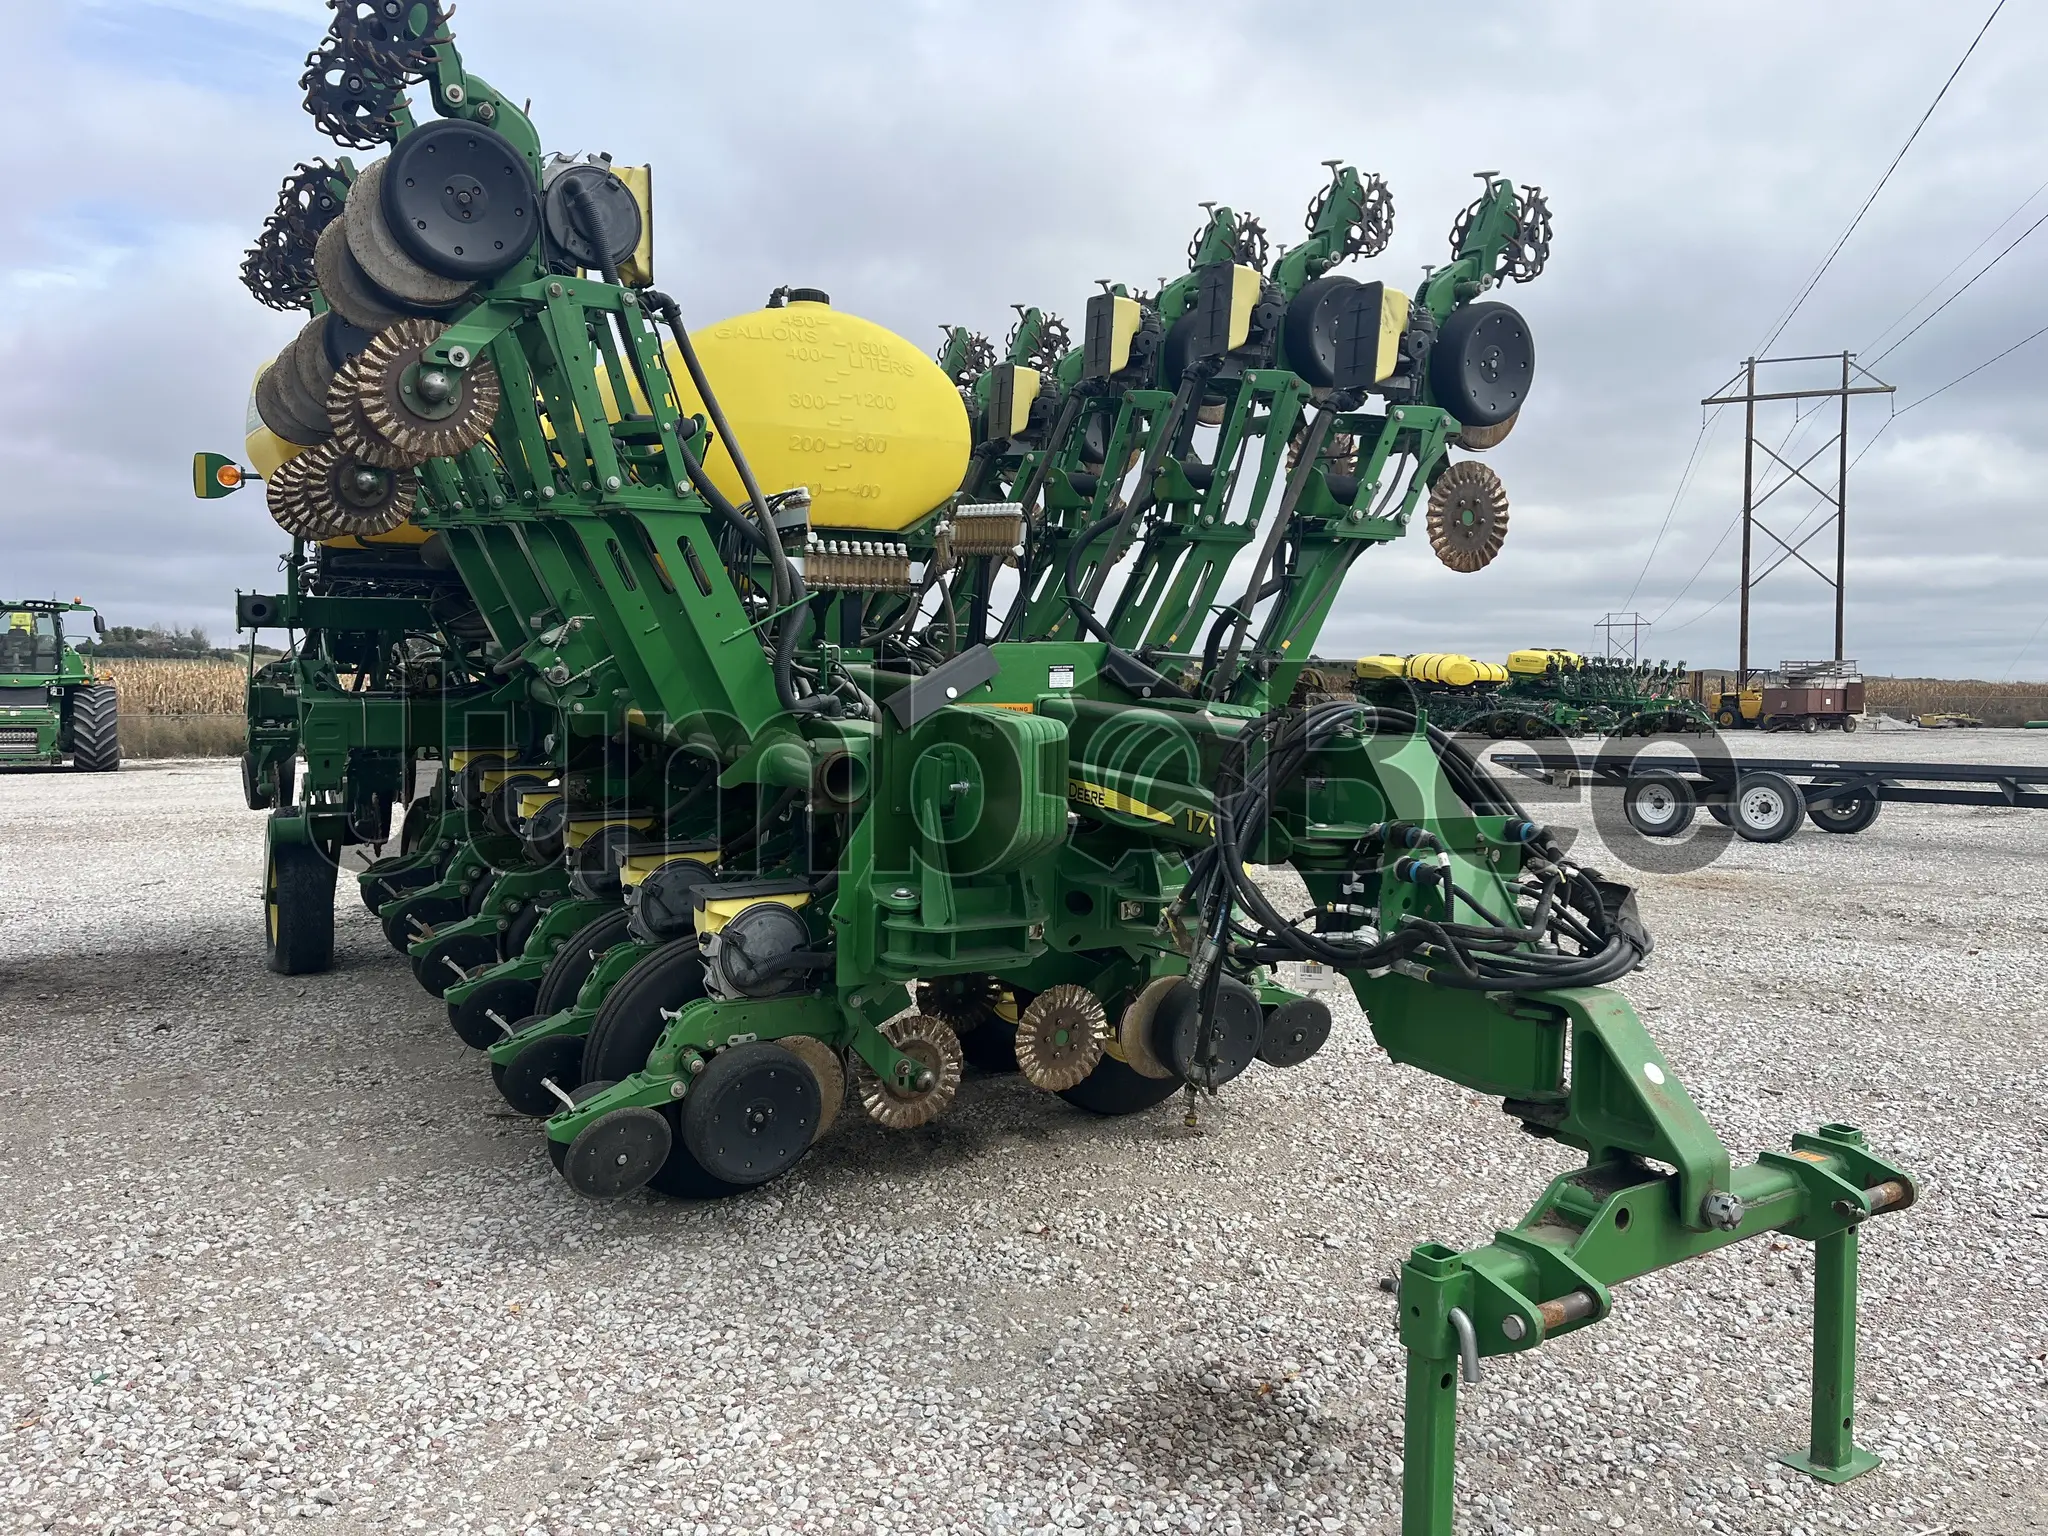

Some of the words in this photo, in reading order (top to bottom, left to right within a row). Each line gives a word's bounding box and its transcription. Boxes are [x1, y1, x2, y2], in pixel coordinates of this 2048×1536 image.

[781, 315, 816, 329] 450
[714, 324, 819, 344] GALLONS
[786, 347, 822, 363] 400
[846, 340, 890, 359] 1600
[848, 352, 916, 377] LITERS
[789, 392, 826, 410] 300
[853, 392, 896, 411] 1200
[788, 434, 826, 453] 200
[854, 435, 888, 454] 800
[848, 483, 882, 499] 400
[1069, 782, 1106, 808] DEERE
